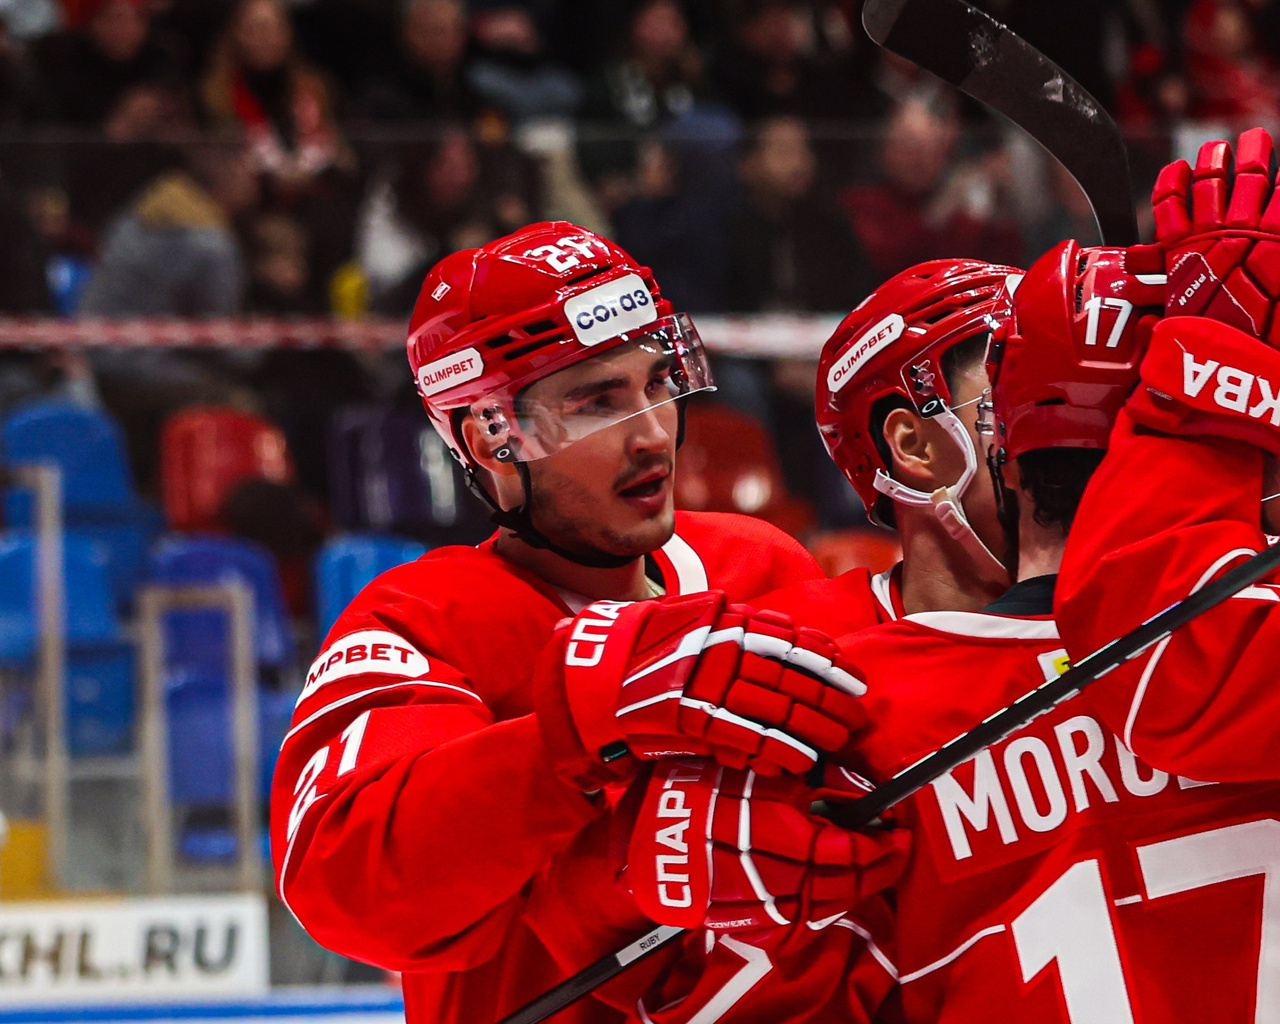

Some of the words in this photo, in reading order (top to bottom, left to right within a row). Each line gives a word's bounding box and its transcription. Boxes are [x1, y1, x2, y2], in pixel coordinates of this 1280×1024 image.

[1083, 296, 1134, 348] 17
[422, 357, 475, 387] OLIMPBET
[833, 322, 896, 382] OLIMPBET
[930, 714, 1220, 861] MOR
[640, 933, 660, 951] RUBY
